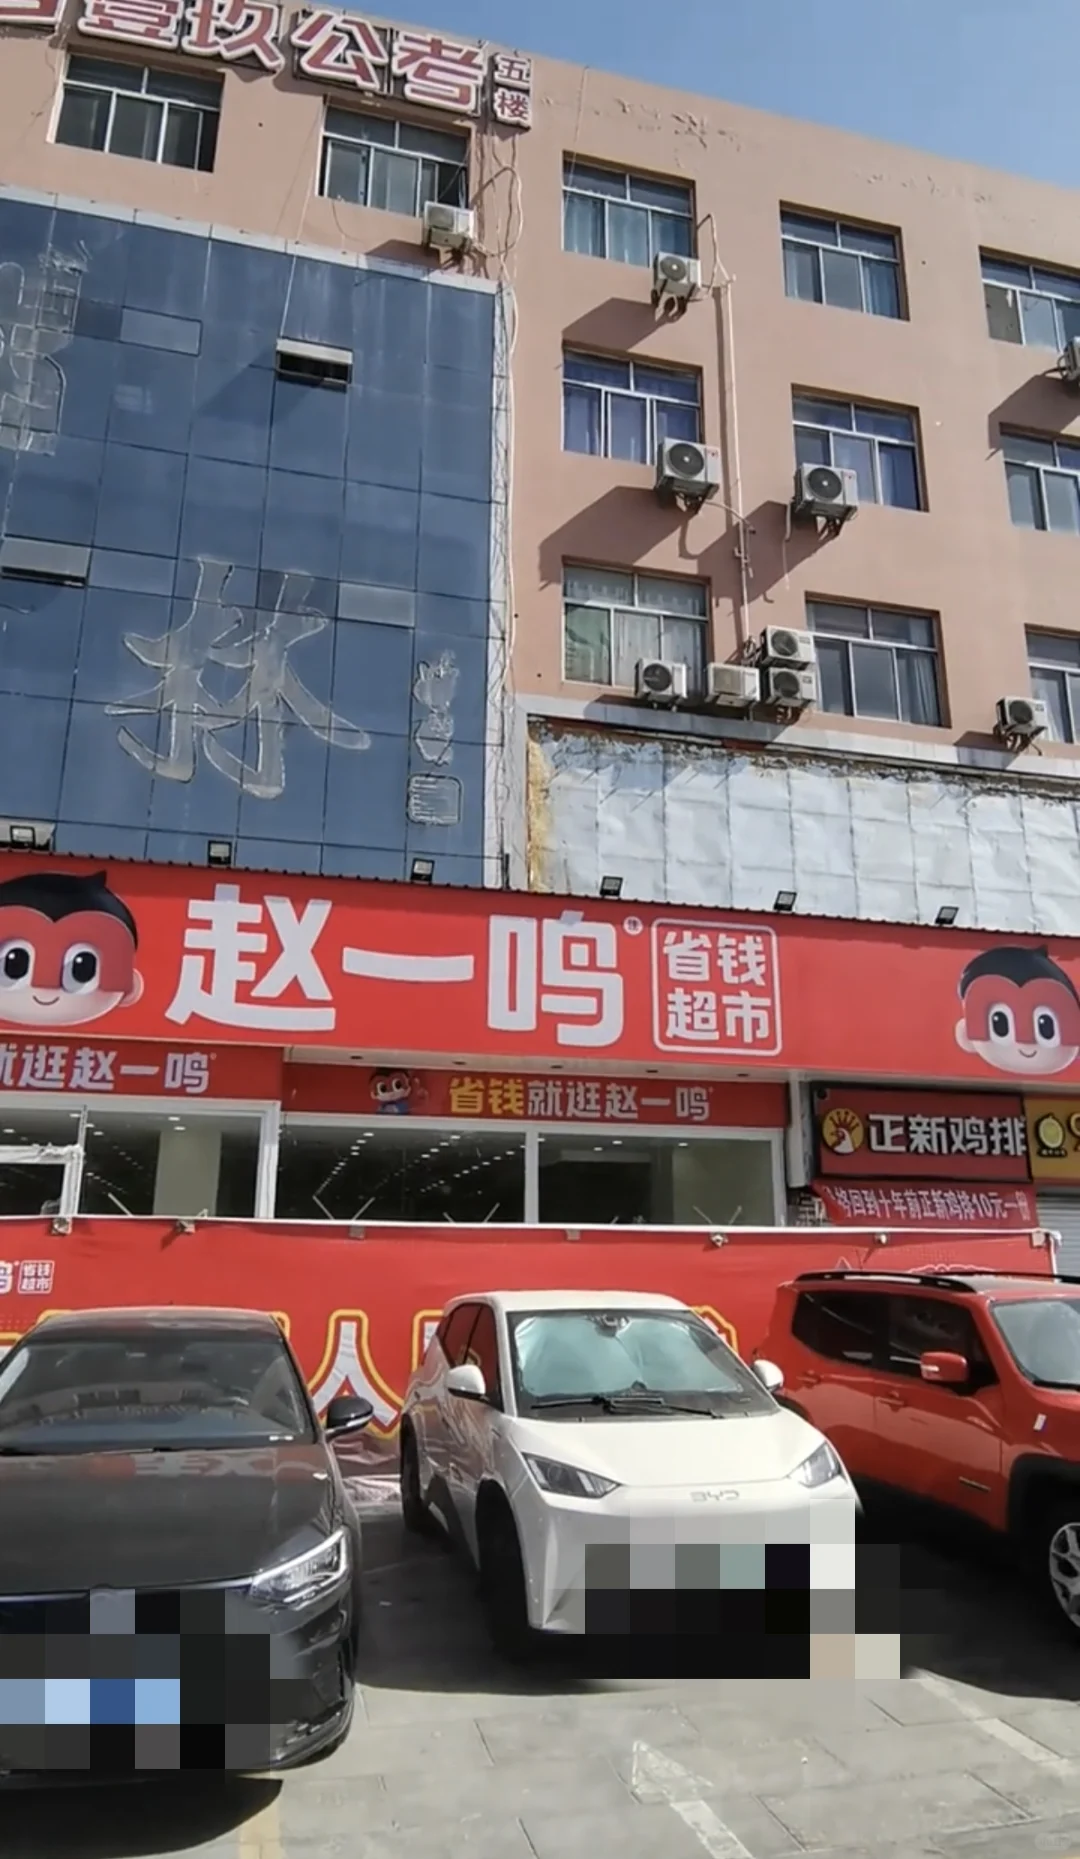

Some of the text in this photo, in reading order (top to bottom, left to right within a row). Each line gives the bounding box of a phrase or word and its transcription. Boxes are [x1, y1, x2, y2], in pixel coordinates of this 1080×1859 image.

[494, 53, 532, 129] 五楼
[165, 884, 624, 1047] 赵一鸣
[663, 930, 766, 986] 省钱
[665, 987, 772, 1043] 超市
[450, 1077, 710, 1121] 省钱就逛赵一鸣
[869, 1114, 1026, 1156] 正新鸡排
[690, 1489, 740, 1502] BYD
